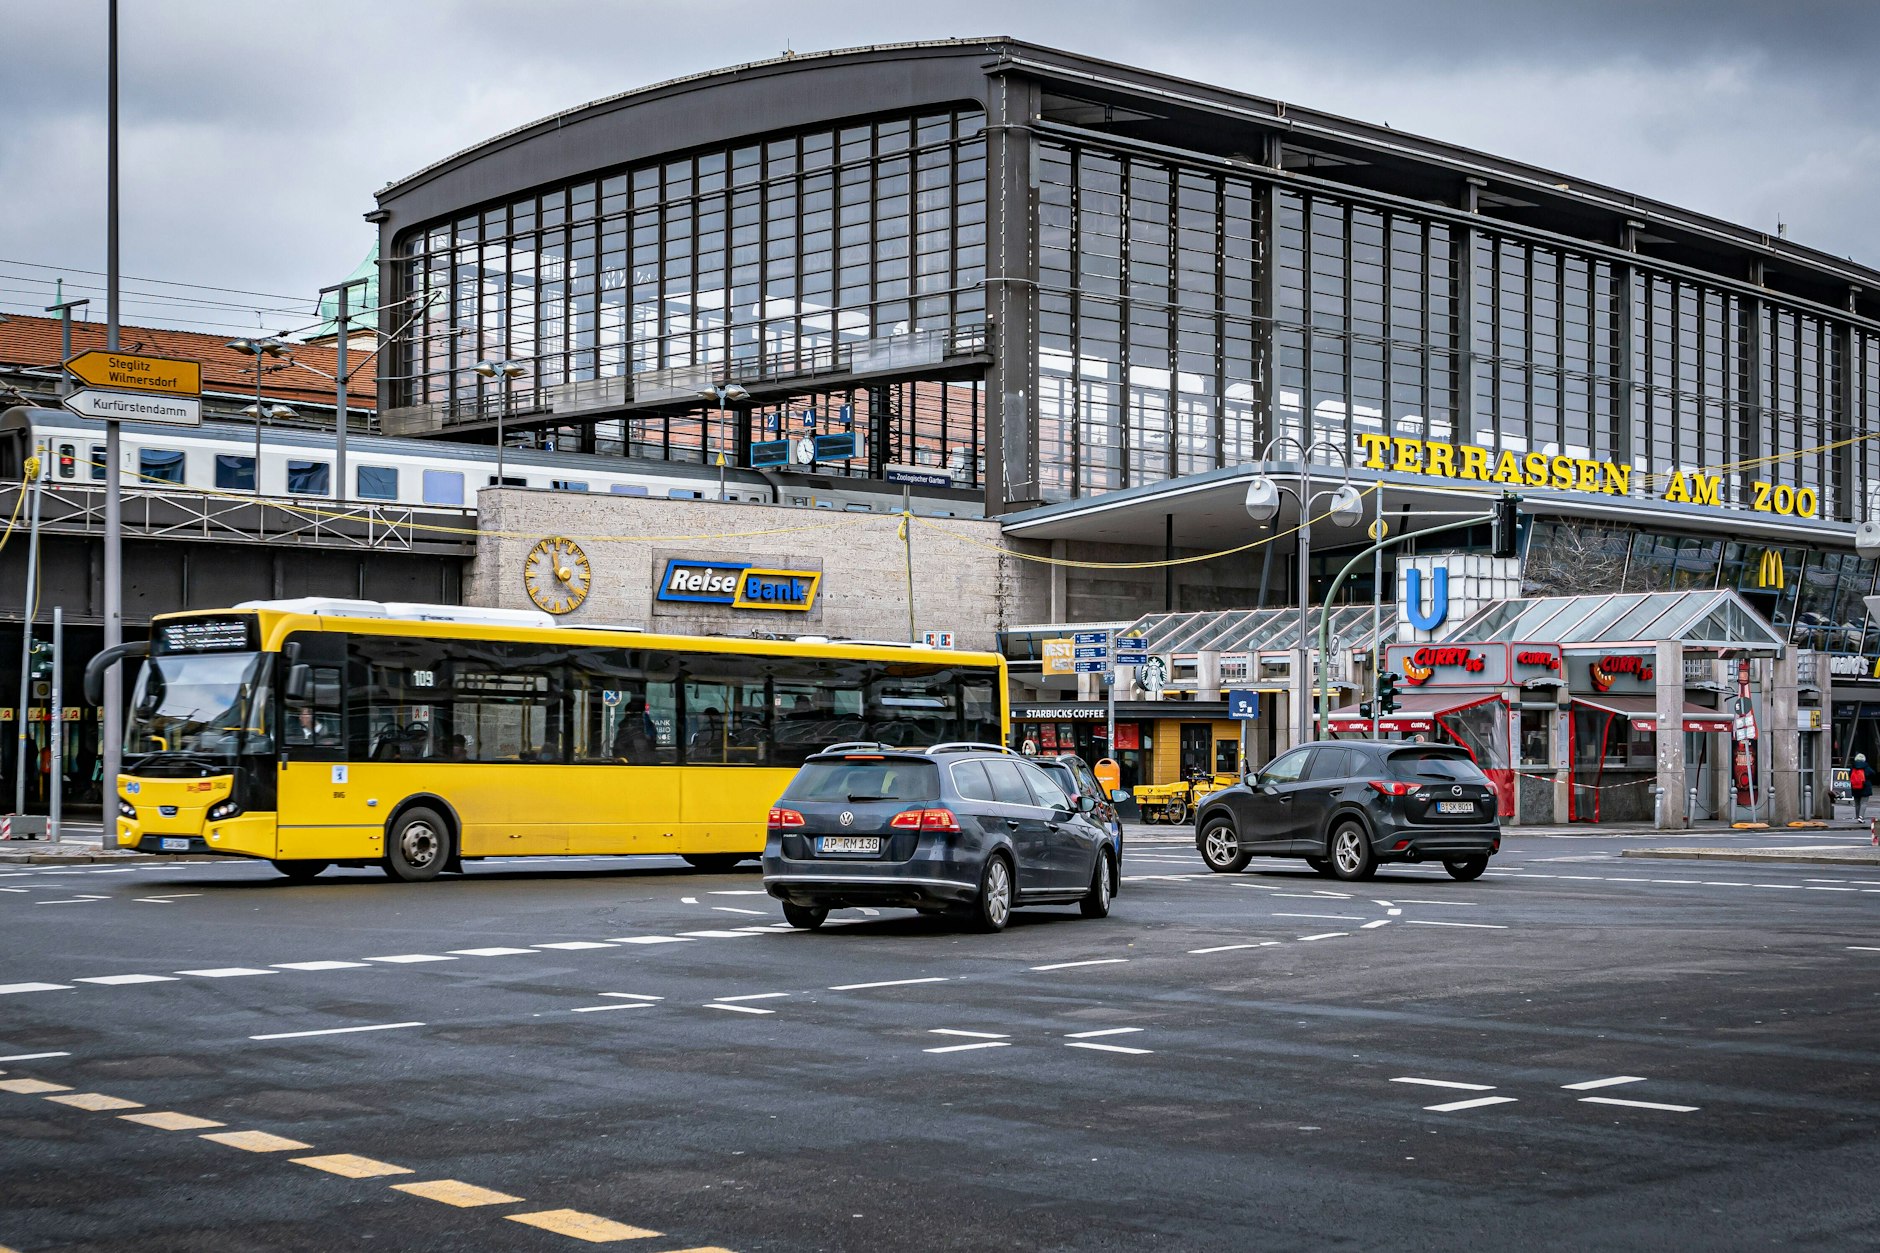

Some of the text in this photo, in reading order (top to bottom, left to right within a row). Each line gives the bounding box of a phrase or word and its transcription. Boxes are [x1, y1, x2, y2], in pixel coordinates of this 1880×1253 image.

[109, 358, 151, 372] Steglitz
[109, 371, 178, 388] Wilmersdorf
[93, 398, 187, 417] Kurfürstendamm
[845, 406, 851, 419] 1
[768, 415, 775, 428] 2
[804, 410, 813, 424] A
[548, 441, 554, 452] 3
[126, 453, 131, 462] 1
[896, 473, 928, 483] Zoologischer
[928, 476, 946, 484] Garten
[1360, 433, 1817, 518] TERRASSEN AM ZOO
[670, 568, 806, 600] Reise Bank
[1406, 567, 1448, 631] U
[1414, 648, 1485, 672] CURRY 36
[1517, 651, 1553, 666] CURRY
[1601, 656, 1654, 681] CURRY 36
[413, 670, 434, 687] 109
[1026, 709, 1105, 718] STARBUCKS COFFEE
[1458, 802, 1473, 811] 8011
[823, 838, 878, 849] AP RM 138
